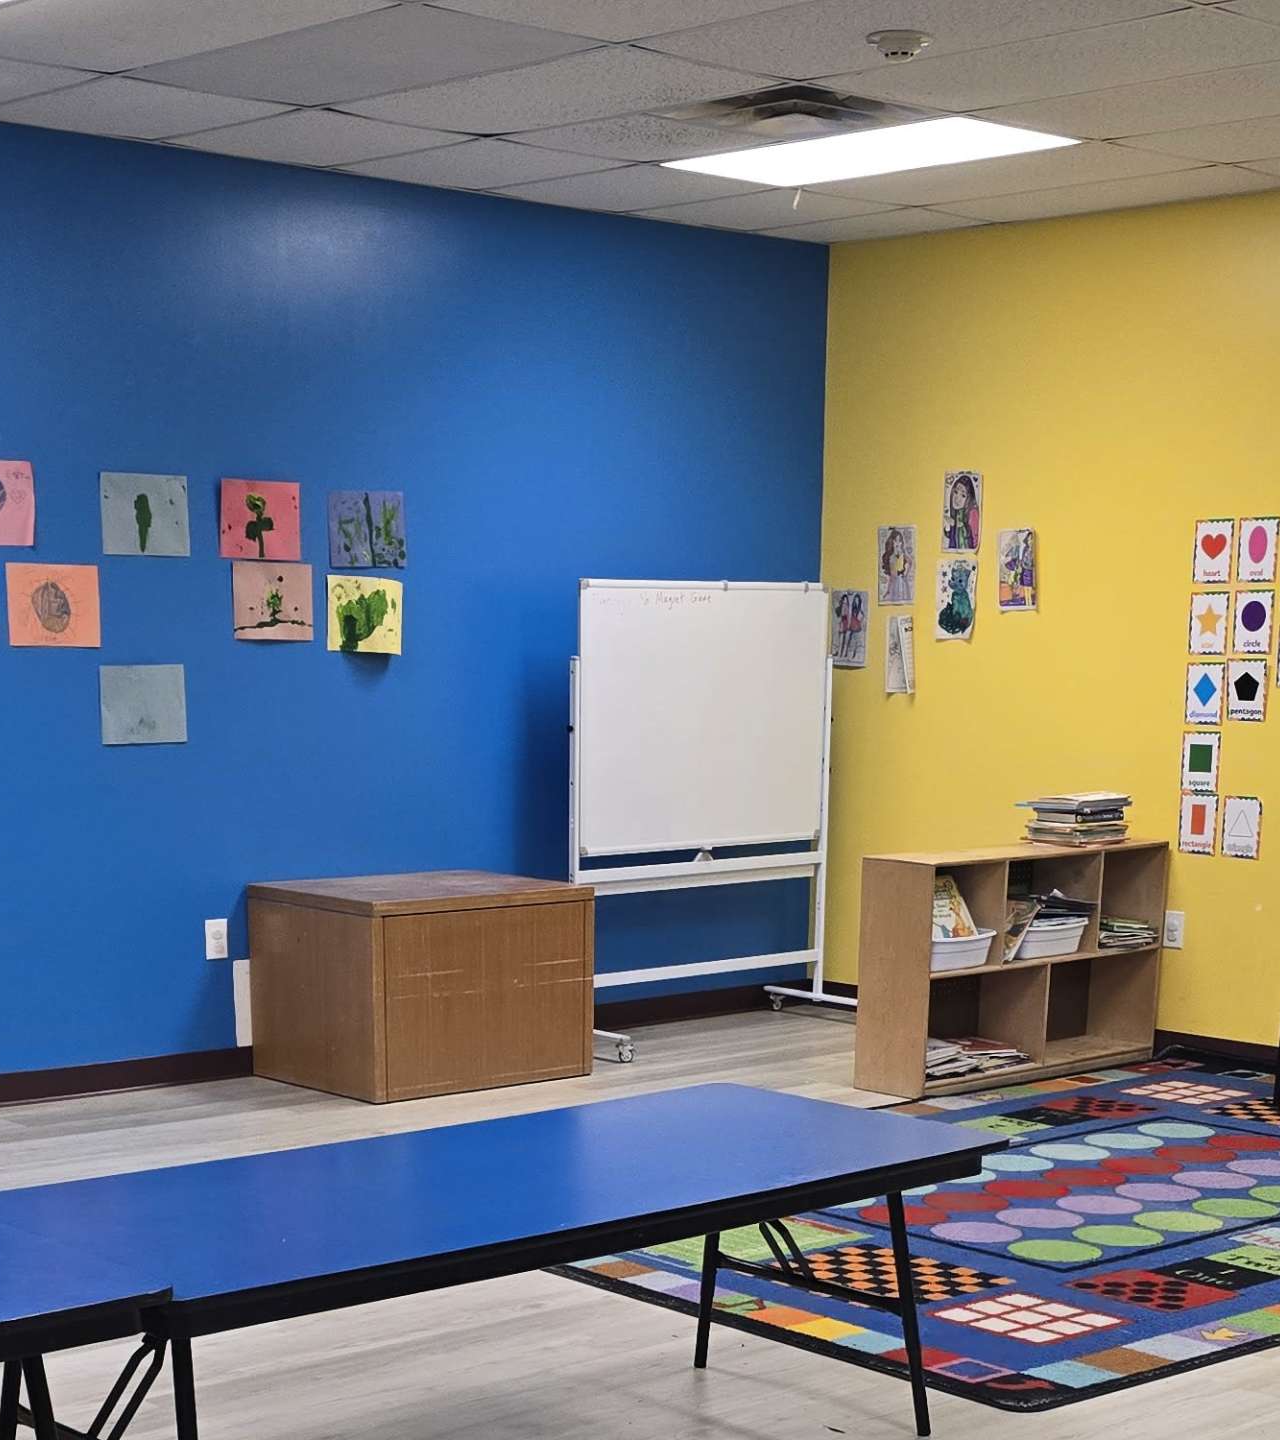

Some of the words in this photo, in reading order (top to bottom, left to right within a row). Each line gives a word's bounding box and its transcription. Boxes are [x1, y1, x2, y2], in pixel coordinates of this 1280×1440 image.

[1243, 639, 1261, 648] circle
[1189, 710, 1217, 719] diamond
[1230, 708, 1262, 716] pentagon
[1182, 840, 1211, 849] rectangle
